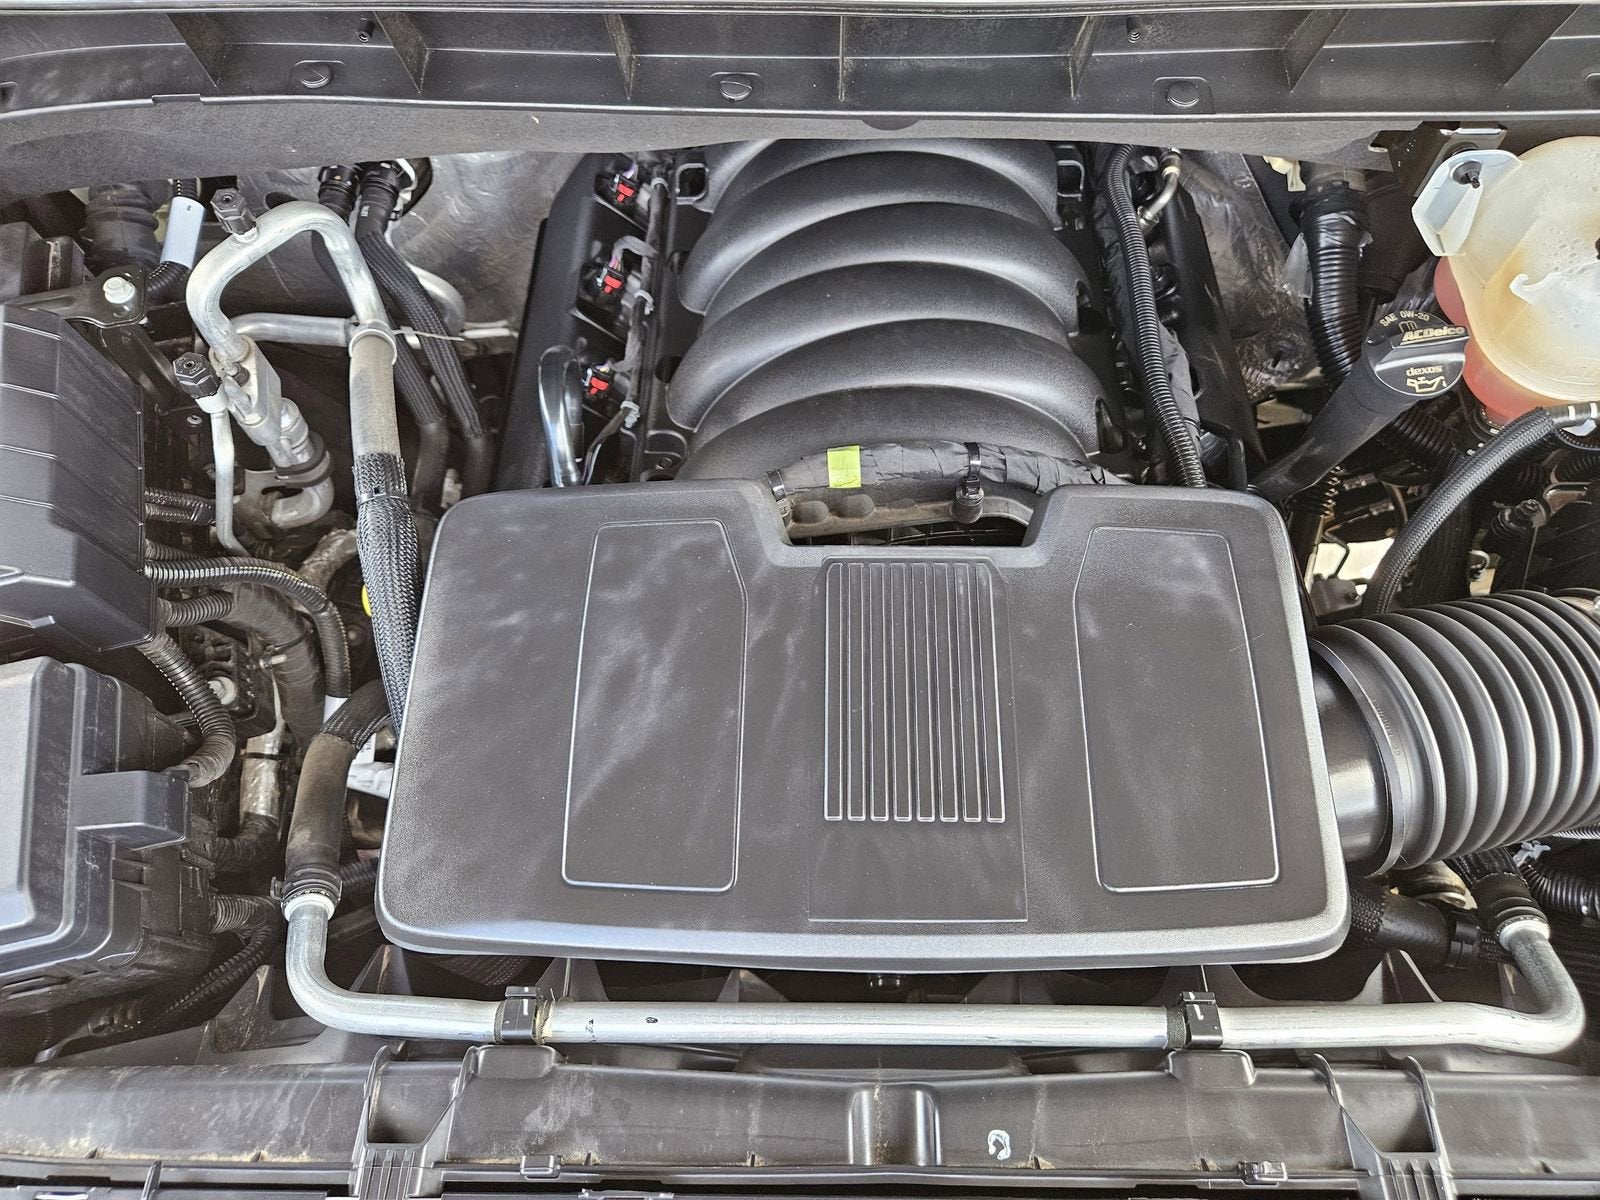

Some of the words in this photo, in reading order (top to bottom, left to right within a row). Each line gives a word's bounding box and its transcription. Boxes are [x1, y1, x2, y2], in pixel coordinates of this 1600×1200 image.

[1379, 312, 1398, 327] SAE
[1400, 310, 1430, 322] 0W-20
[1401, 326, 1465, 342] ACDelco
[1406, 365, 1443, 376] dexos
